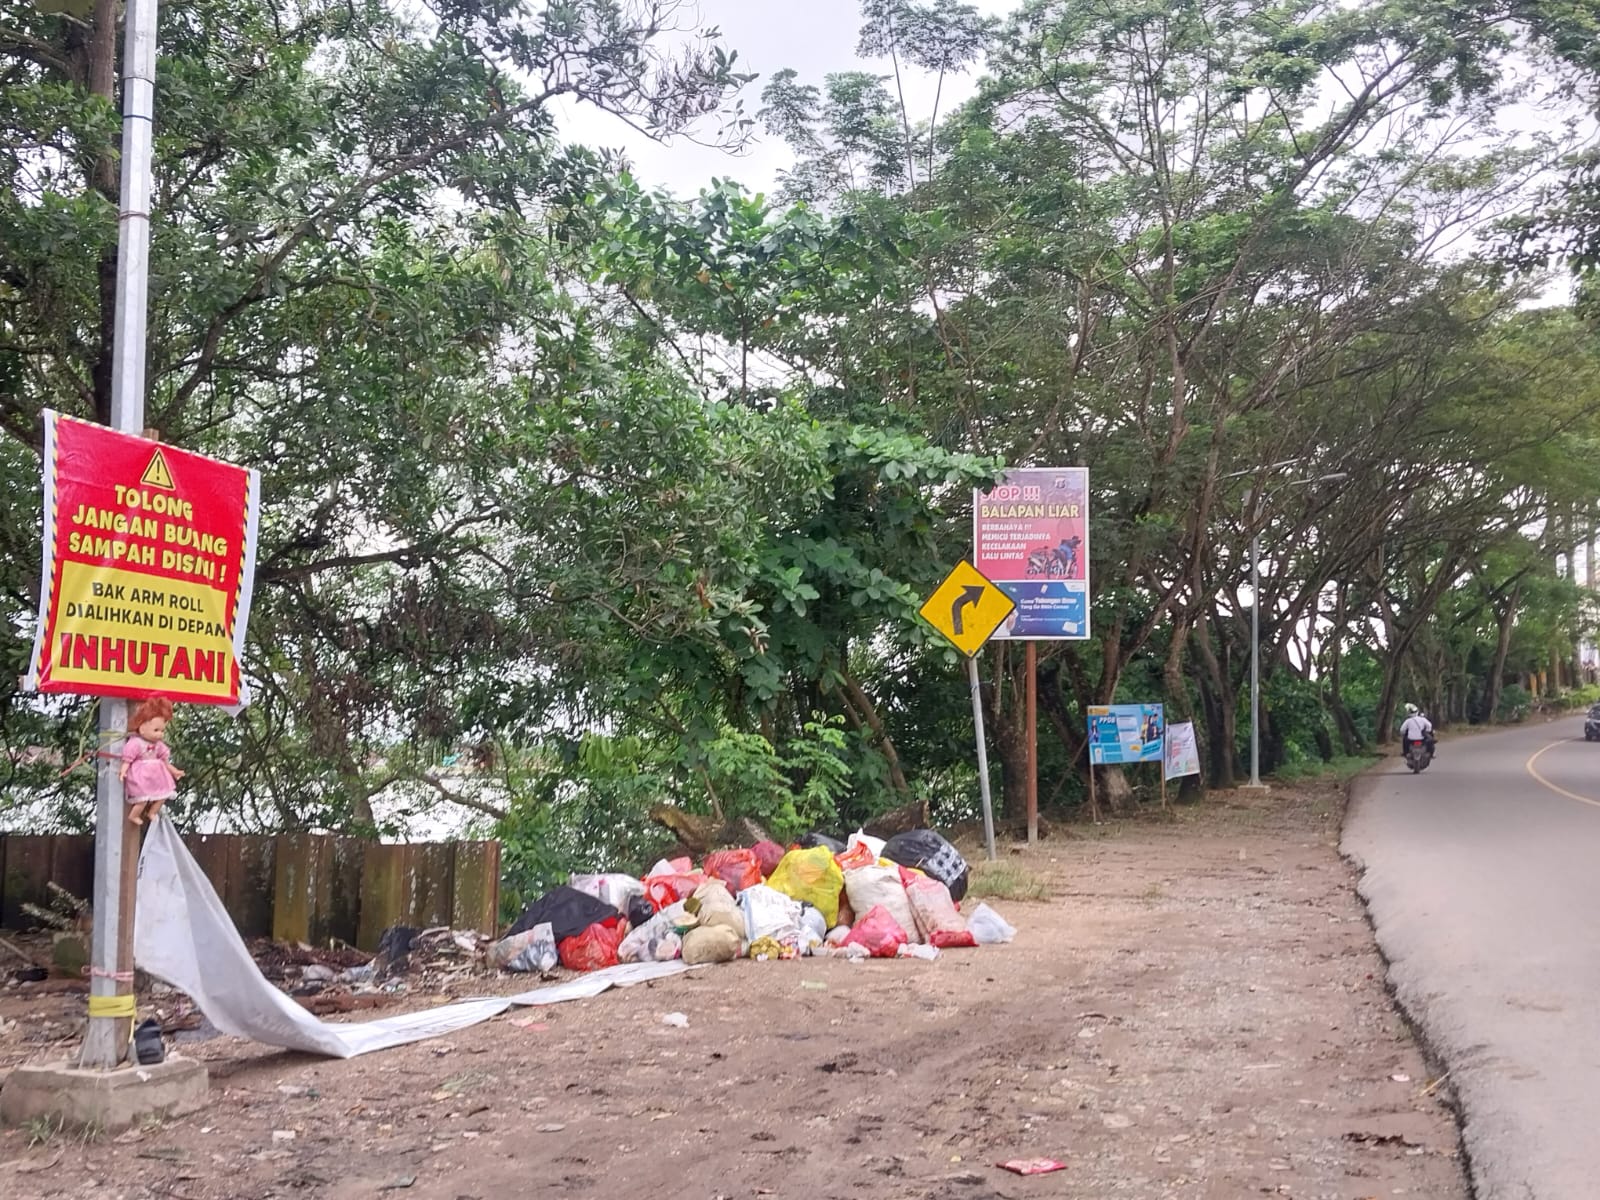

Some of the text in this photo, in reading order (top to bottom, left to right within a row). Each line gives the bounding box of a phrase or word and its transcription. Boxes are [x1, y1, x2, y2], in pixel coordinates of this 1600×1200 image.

[114, 484, 193, 521] TOLONG
[981, 504, 1080, 518] BALAPAN LIAR
[72, 504, 228, 557] JANGAN BUANG
[68, 532, 155, 566] SAMPAH
[92, 582, 204, 613] BAK ARM ROLL
[66, 602, 226, 638] DIALIHKAN DI DEPAN
[60, 632, 226, 684] INHUTANI
